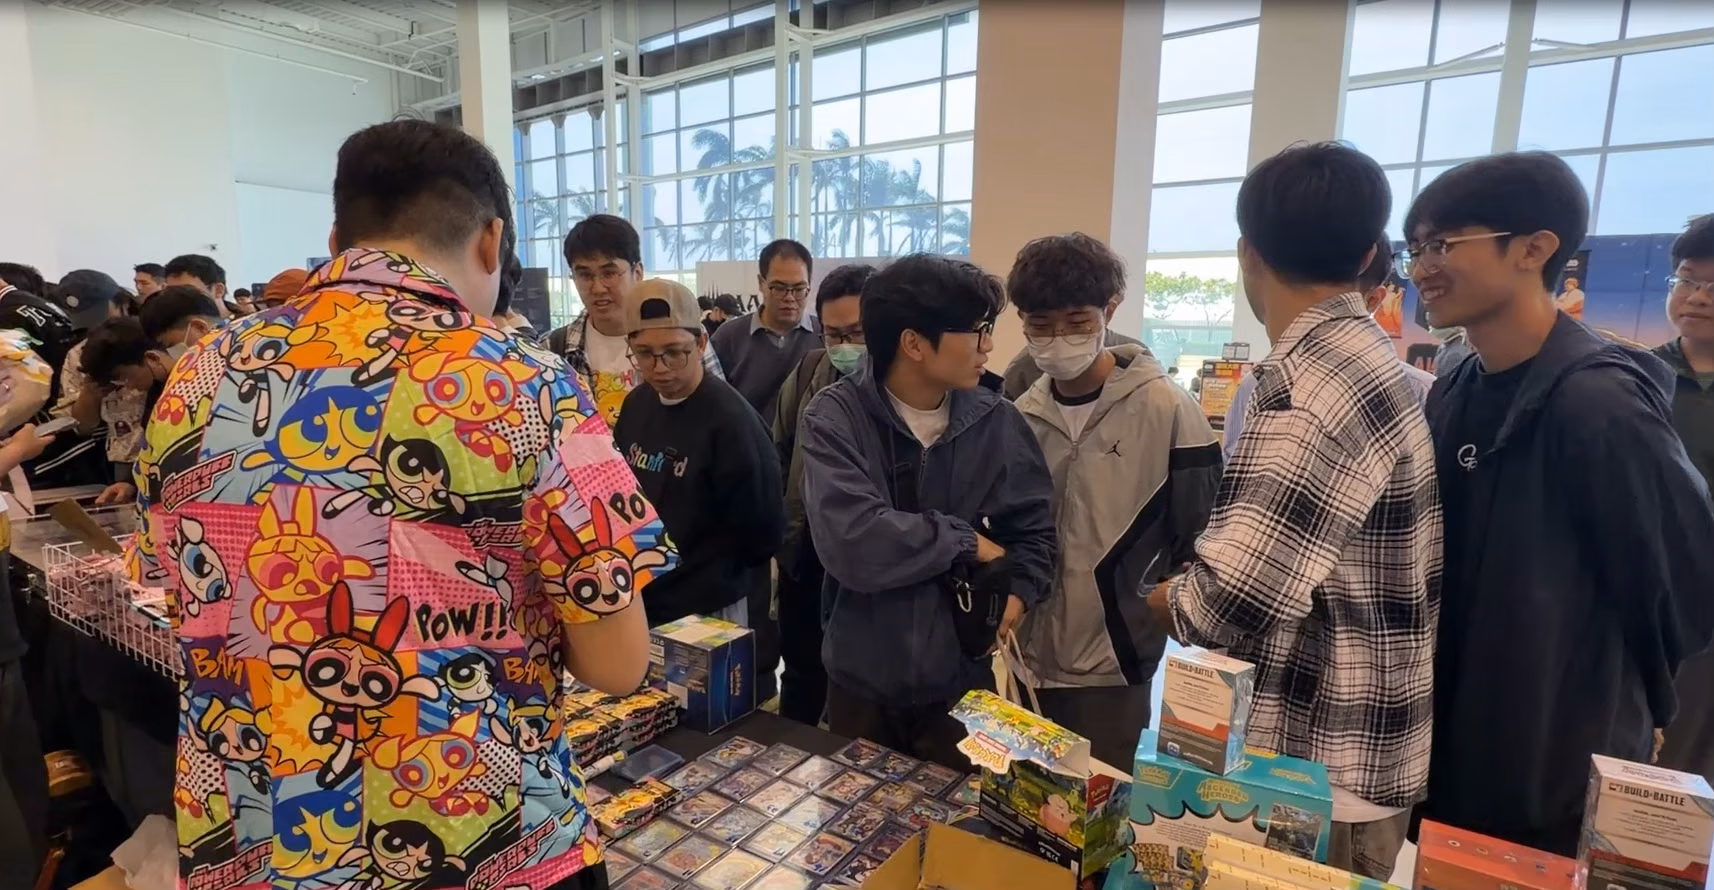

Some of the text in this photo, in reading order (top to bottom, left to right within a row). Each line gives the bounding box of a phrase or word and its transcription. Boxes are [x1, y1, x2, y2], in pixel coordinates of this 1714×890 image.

[190, 647, 244, 686] BAM
[1624, 785, 1685, 806] BUILD BATTLE
